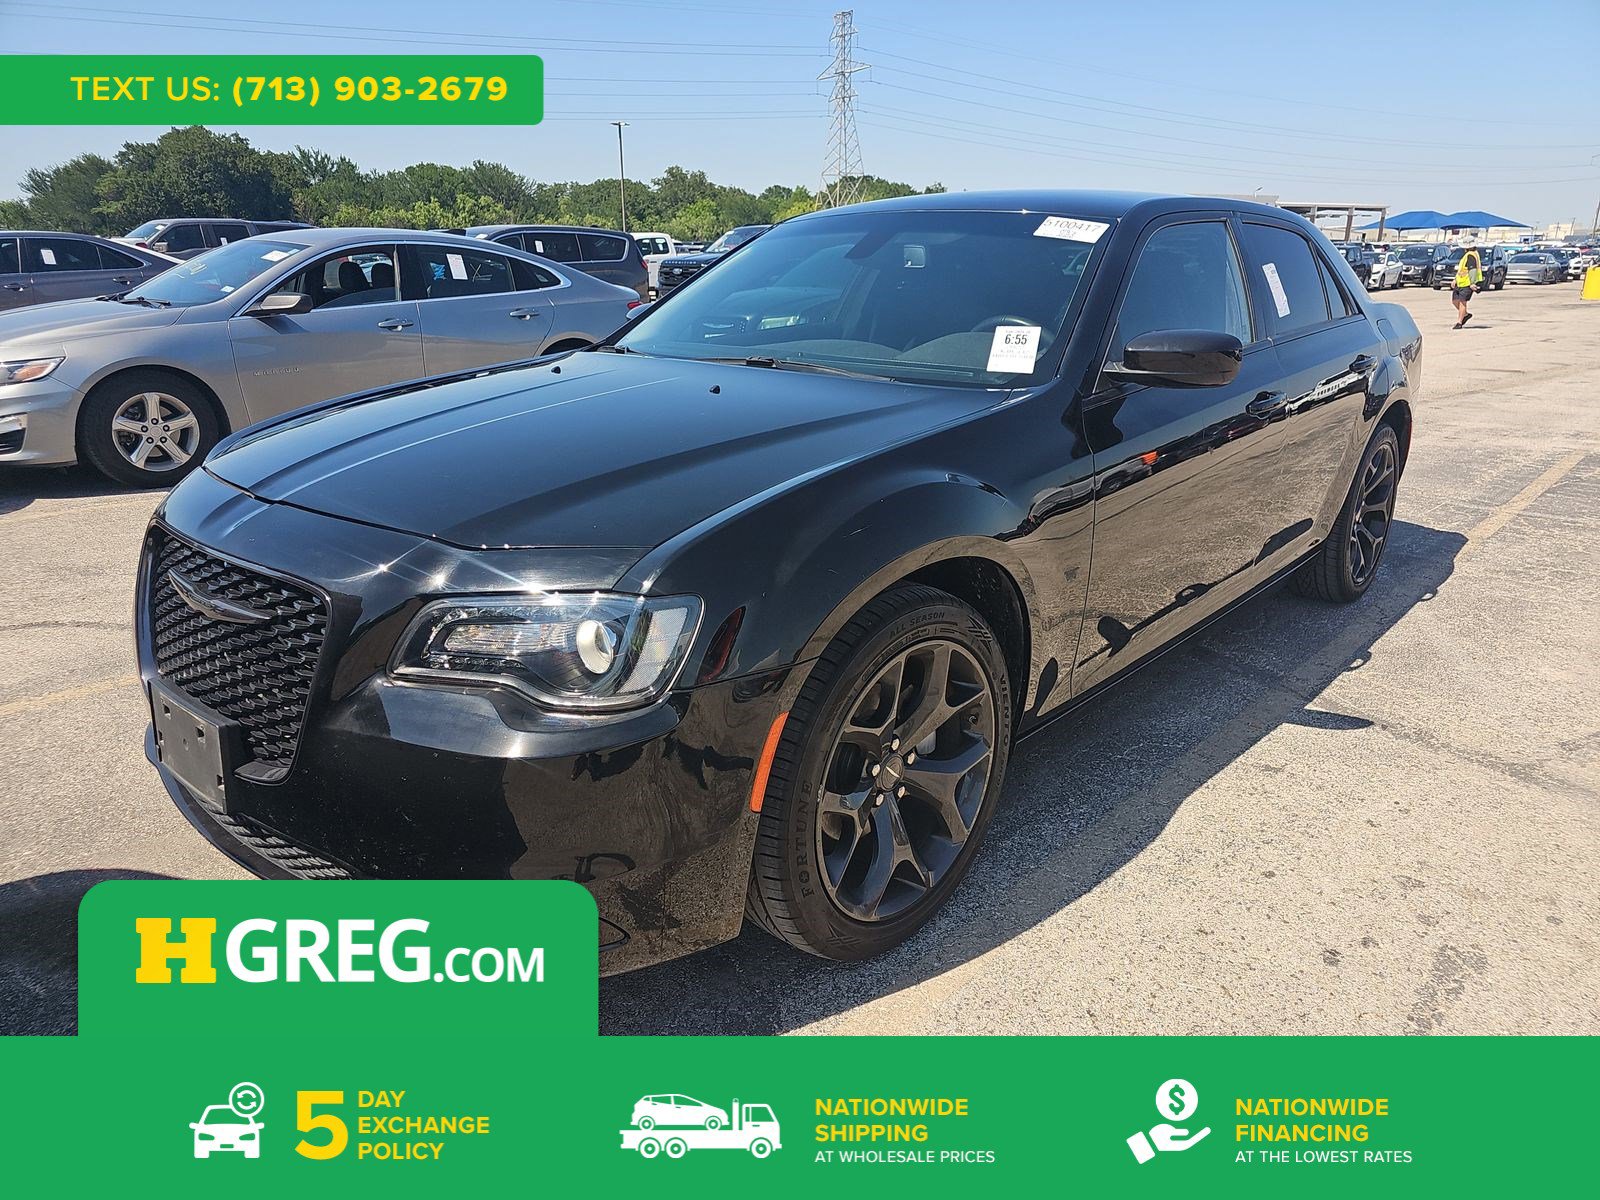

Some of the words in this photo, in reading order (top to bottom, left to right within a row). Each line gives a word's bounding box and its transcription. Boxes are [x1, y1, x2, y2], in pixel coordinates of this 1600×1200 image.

[1004, 333, 1028, 345] 6:55
[889, 623, 906, 639] ALL
[910, 612, 945, 626] SEASON
[1000, 674, 1010, 747] VIENTO
[795, 781, 815, 899] FORTUNE
